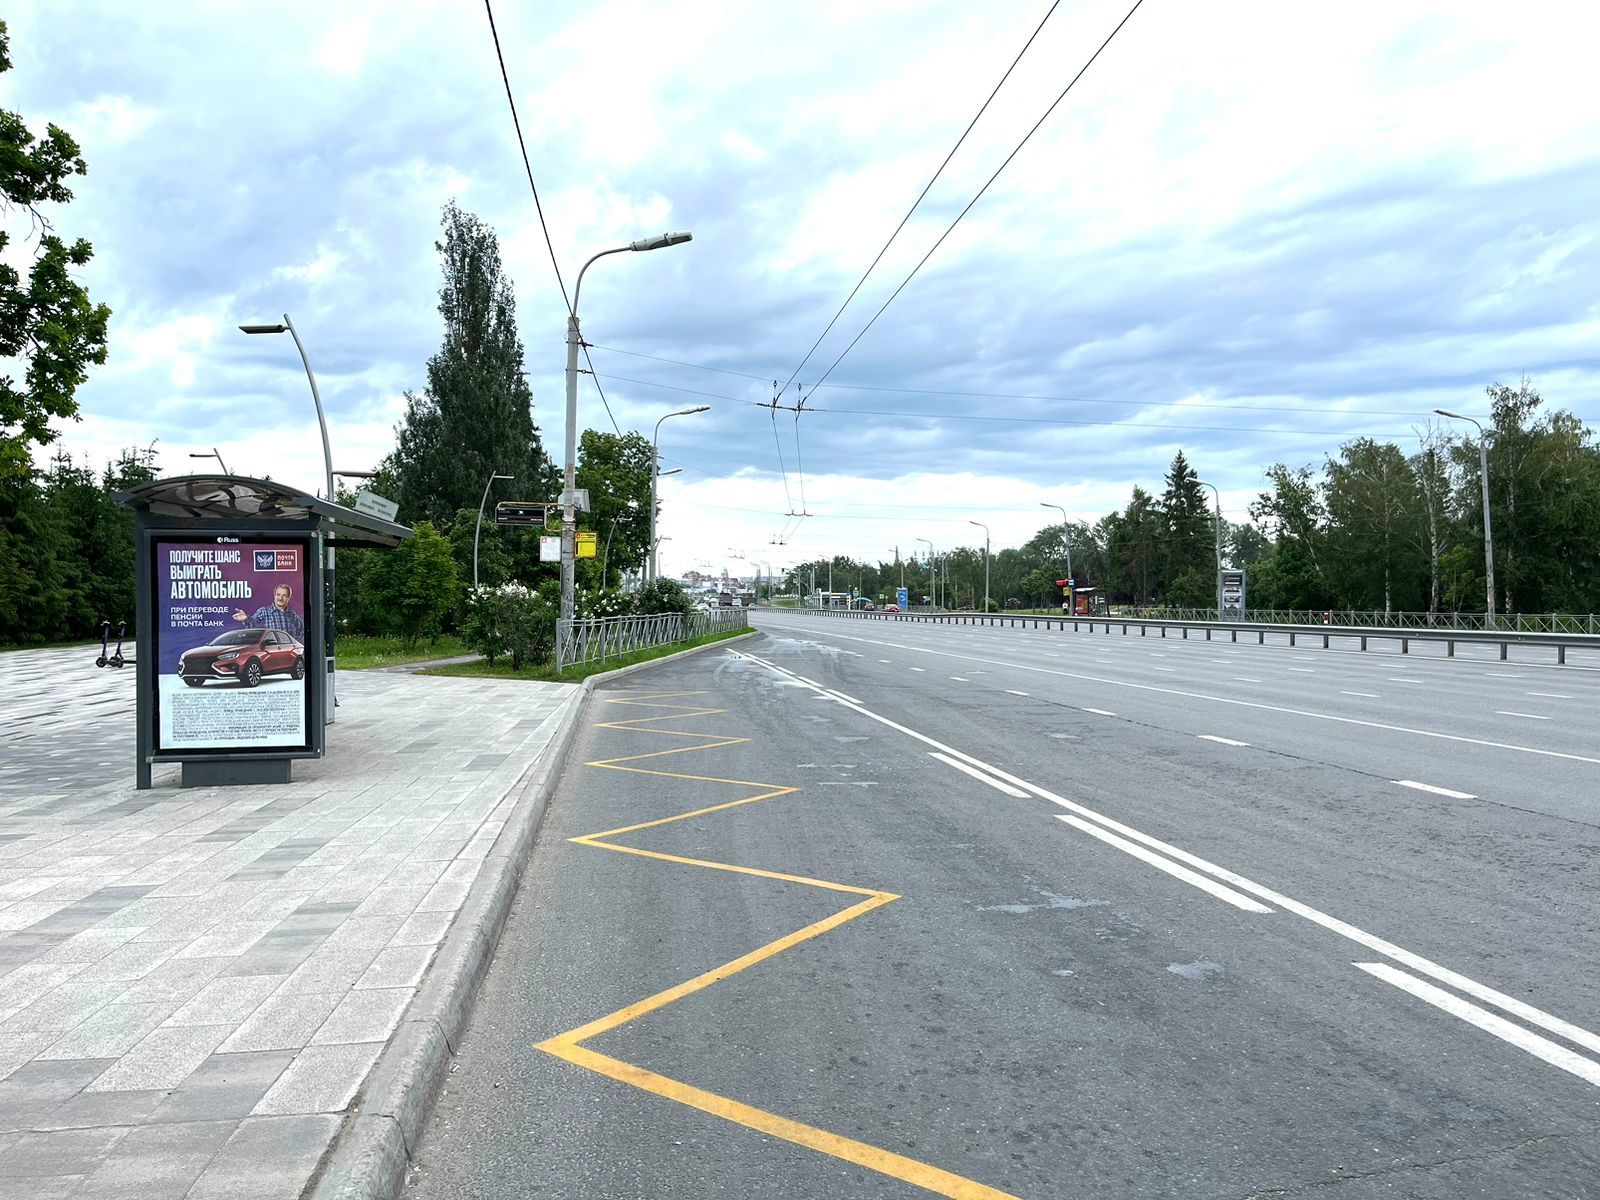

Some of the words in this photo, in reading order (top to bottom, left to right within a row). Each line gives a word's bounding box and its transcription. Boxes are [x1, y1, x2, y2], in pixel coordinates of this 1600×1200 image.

[169, 550, 213, 563] ПОЛУЧИТЕ
[215, 550, 241, 563] ШАНС
[170, 565, 222, 579] ВЫИГРАТЬ
[171, 581, 252, 599] АВТОМОБИЛЬ
[188, 606, 229, 614] ПЕРЕВОДЕ
